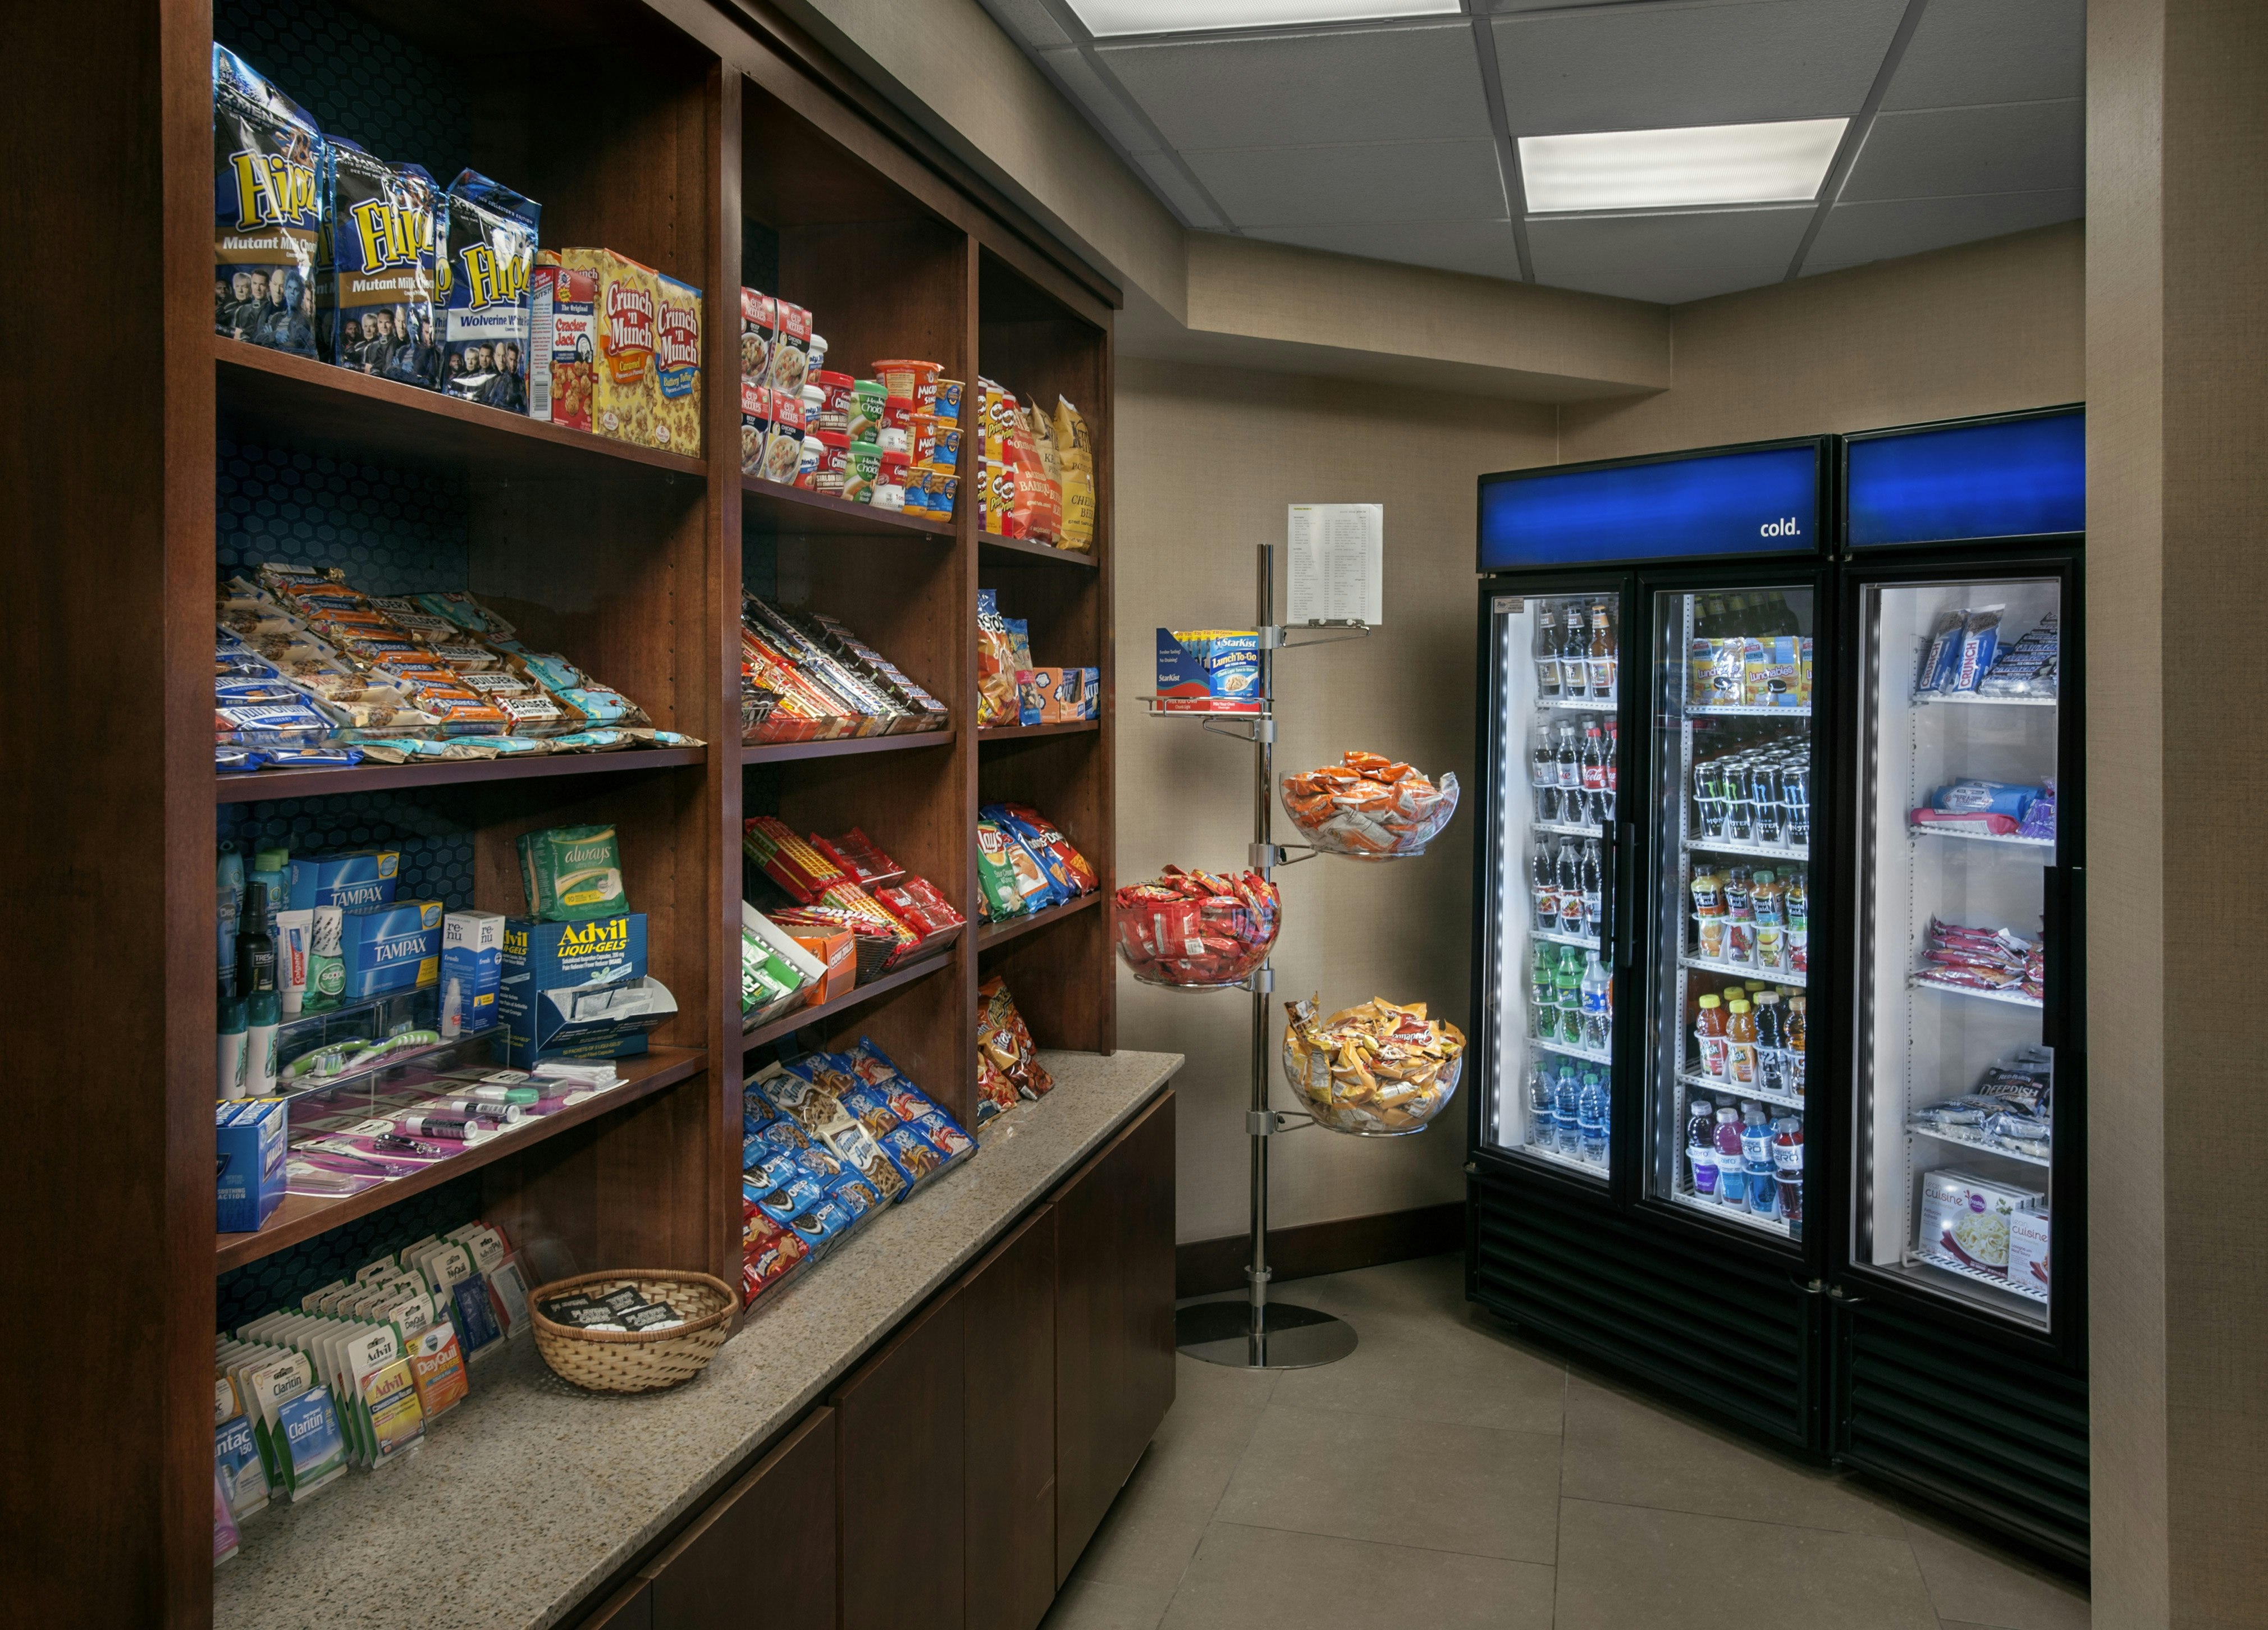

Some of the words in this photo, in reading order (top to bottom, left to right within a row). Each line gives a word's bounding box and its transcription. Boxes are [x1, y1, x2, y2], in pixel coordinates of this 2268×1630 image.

[516, 214, 533, 224] EDITION
[222, 236, 278, 250] Mutant
[352, 277, 397, 292] Mutant
[398, 277, 415, 289] Milk
[570, 304, 588, 313] Original
[607, 283, 653, 319] Crunch
[750, 297, 763, 310] CUP
[460, 315, 507, 327] Wolverine
[628, 312, 638, 324] 'n
[657, 303, 697, 336] Crunch
[746, 308, 766, 323] NOODLES
[790, 313, 802, 323] CUP
[555, 318, 587, 332] Cracker
[787, 319, 804, 336] NOODLES
[555, 333, 575, 346] Jack
[610, 317, 653, 350] Munch
[675, 329, 684, 342] 'n
[788, 335, 802, 345] CHICKEN
[661, 336, 697, 365] Munch
[619, 356, 641, 372] Caramel
[663, 375, 679, 387] Buttery
[746, 391, 758, 403] CUP
[742, 398, 762, 414] NOODLES
[784, 401, 795, 413] CUP
[861, 403, 883, 415] Choice
[780, 409, 798, 425] NOODLES
[781, 424, 796, 434] CHICKEN
[856, 464, 878, 475] Choice
[1761, 517, 1800, 537] cold.
[1222, 638, 1256, 648] StarKist
[1213, 654, 1237, 669] Lunch
[1921, 642, 1941, 688] CRUNCH
[1960, 642, 1978, 688] CRUNCH
[1159, 673, 1180, 682] StarKist
[1749, 666, 1794, 683] Lunchables
[1585, 768, 1603, 781] Cola
[565, 845, 611, 865] always
[330, 885, 383, 908] TAMPAX
[220, 907, 235, 919] Dep
[446, 931, 462, 941] nu
[481, 934, 493, 944] nu
[557, 918, 628, 946] Advil
[374, 936, 427, 962] TAMPAX
[557, 939, 628, 958] LIQUI-GELS
[830, 954, 842, 969] COW
[842, 940, 854, 960] TALES
[322, 970, 345, 982] scope
[763, 1155, 785, 1173] OREO
[787, 1180, 808, 1197] OREO
[1926, 1180, 1942, 1191] lean
[1925, 1188, 1963, 1206] cuisine
[817, 1203, 835, 1221] OREO
[2011, 1219, 2028, 1227] lean
[2011, 1225, 2048, 1243] cuisine
[367, 1342, 392, 1364] Advil
[417, 1344, 458, 1375] DayQuil
[438, 1357, 460, 1372] SEVERE
[273, 1375, 303, 1396] Claritin
[374, 1372, 404, 1399] Advil
[288, 1412, 323, 1440] Claritin
[239, 1441, 253, 1456] 150
